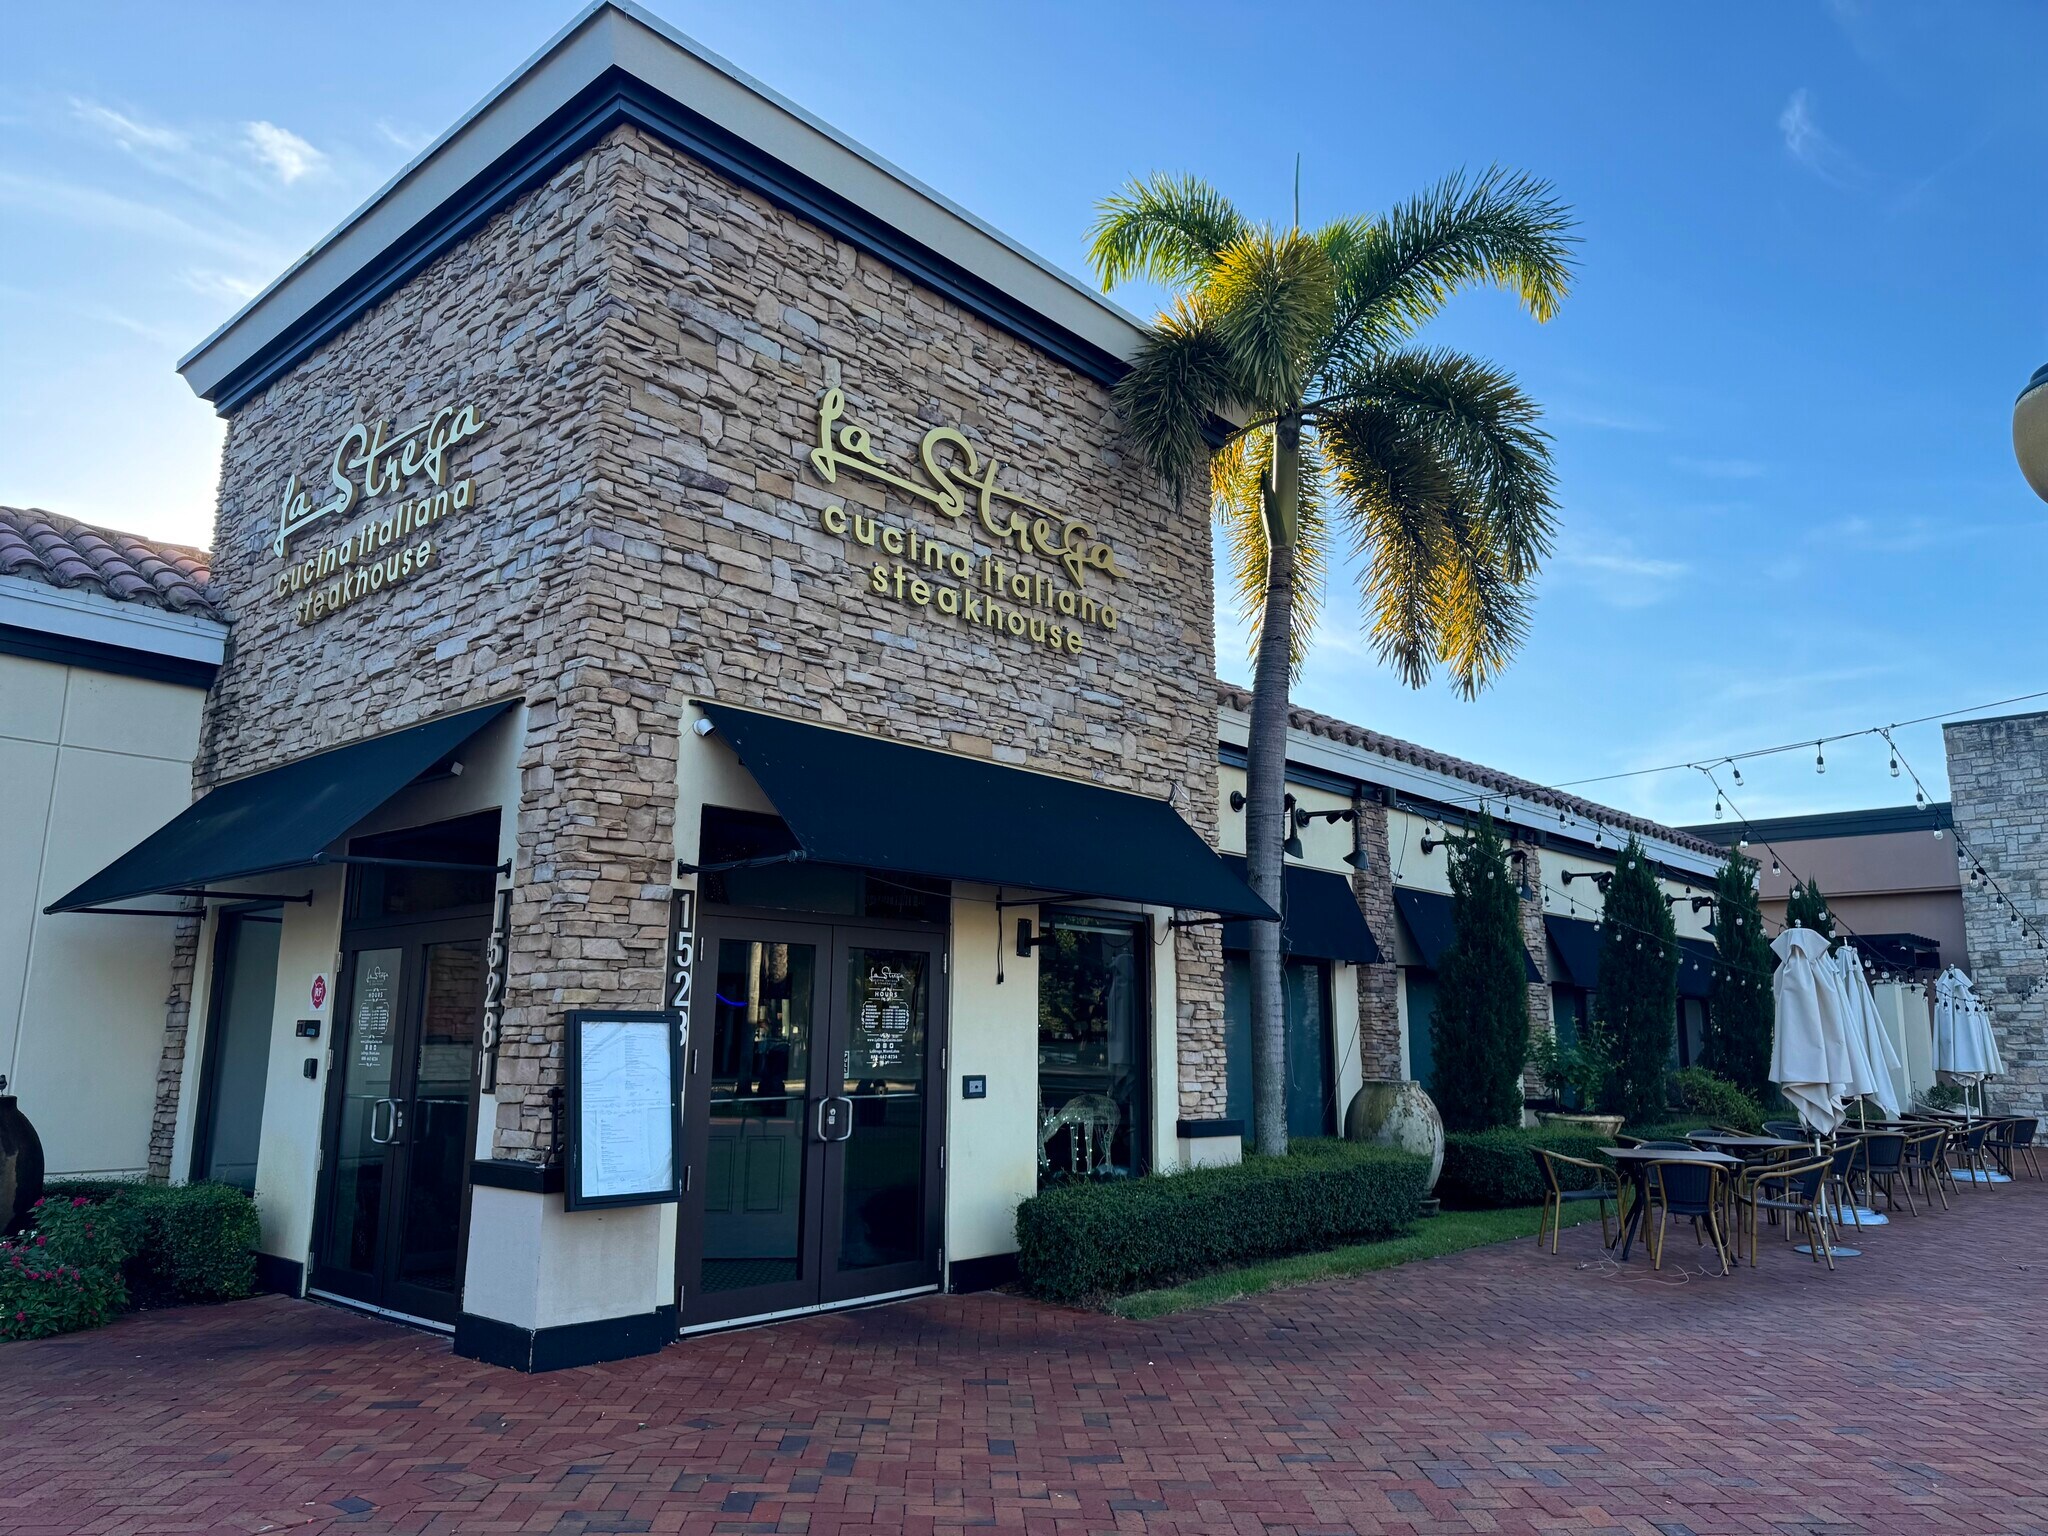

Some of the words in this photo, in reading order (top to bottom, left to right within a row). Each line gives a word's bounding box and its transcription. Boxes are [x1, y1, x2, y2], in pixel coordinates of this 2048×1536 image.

[273, 474, 315, 558] La
[332, 404, 488, 514] Strega
[276, 537, 357, 598] cucina
[359, 478, 475, 557] italiana
[810, 387, 888, 484] La
[919, 426, 1127, 590] Strega
[296, 540, 436, 627] steakhouse
[821, 504, 970, 580] cucina
[981, 555, 1118, 632] italiana
[870, 564, 1084, 655] steakhouse
